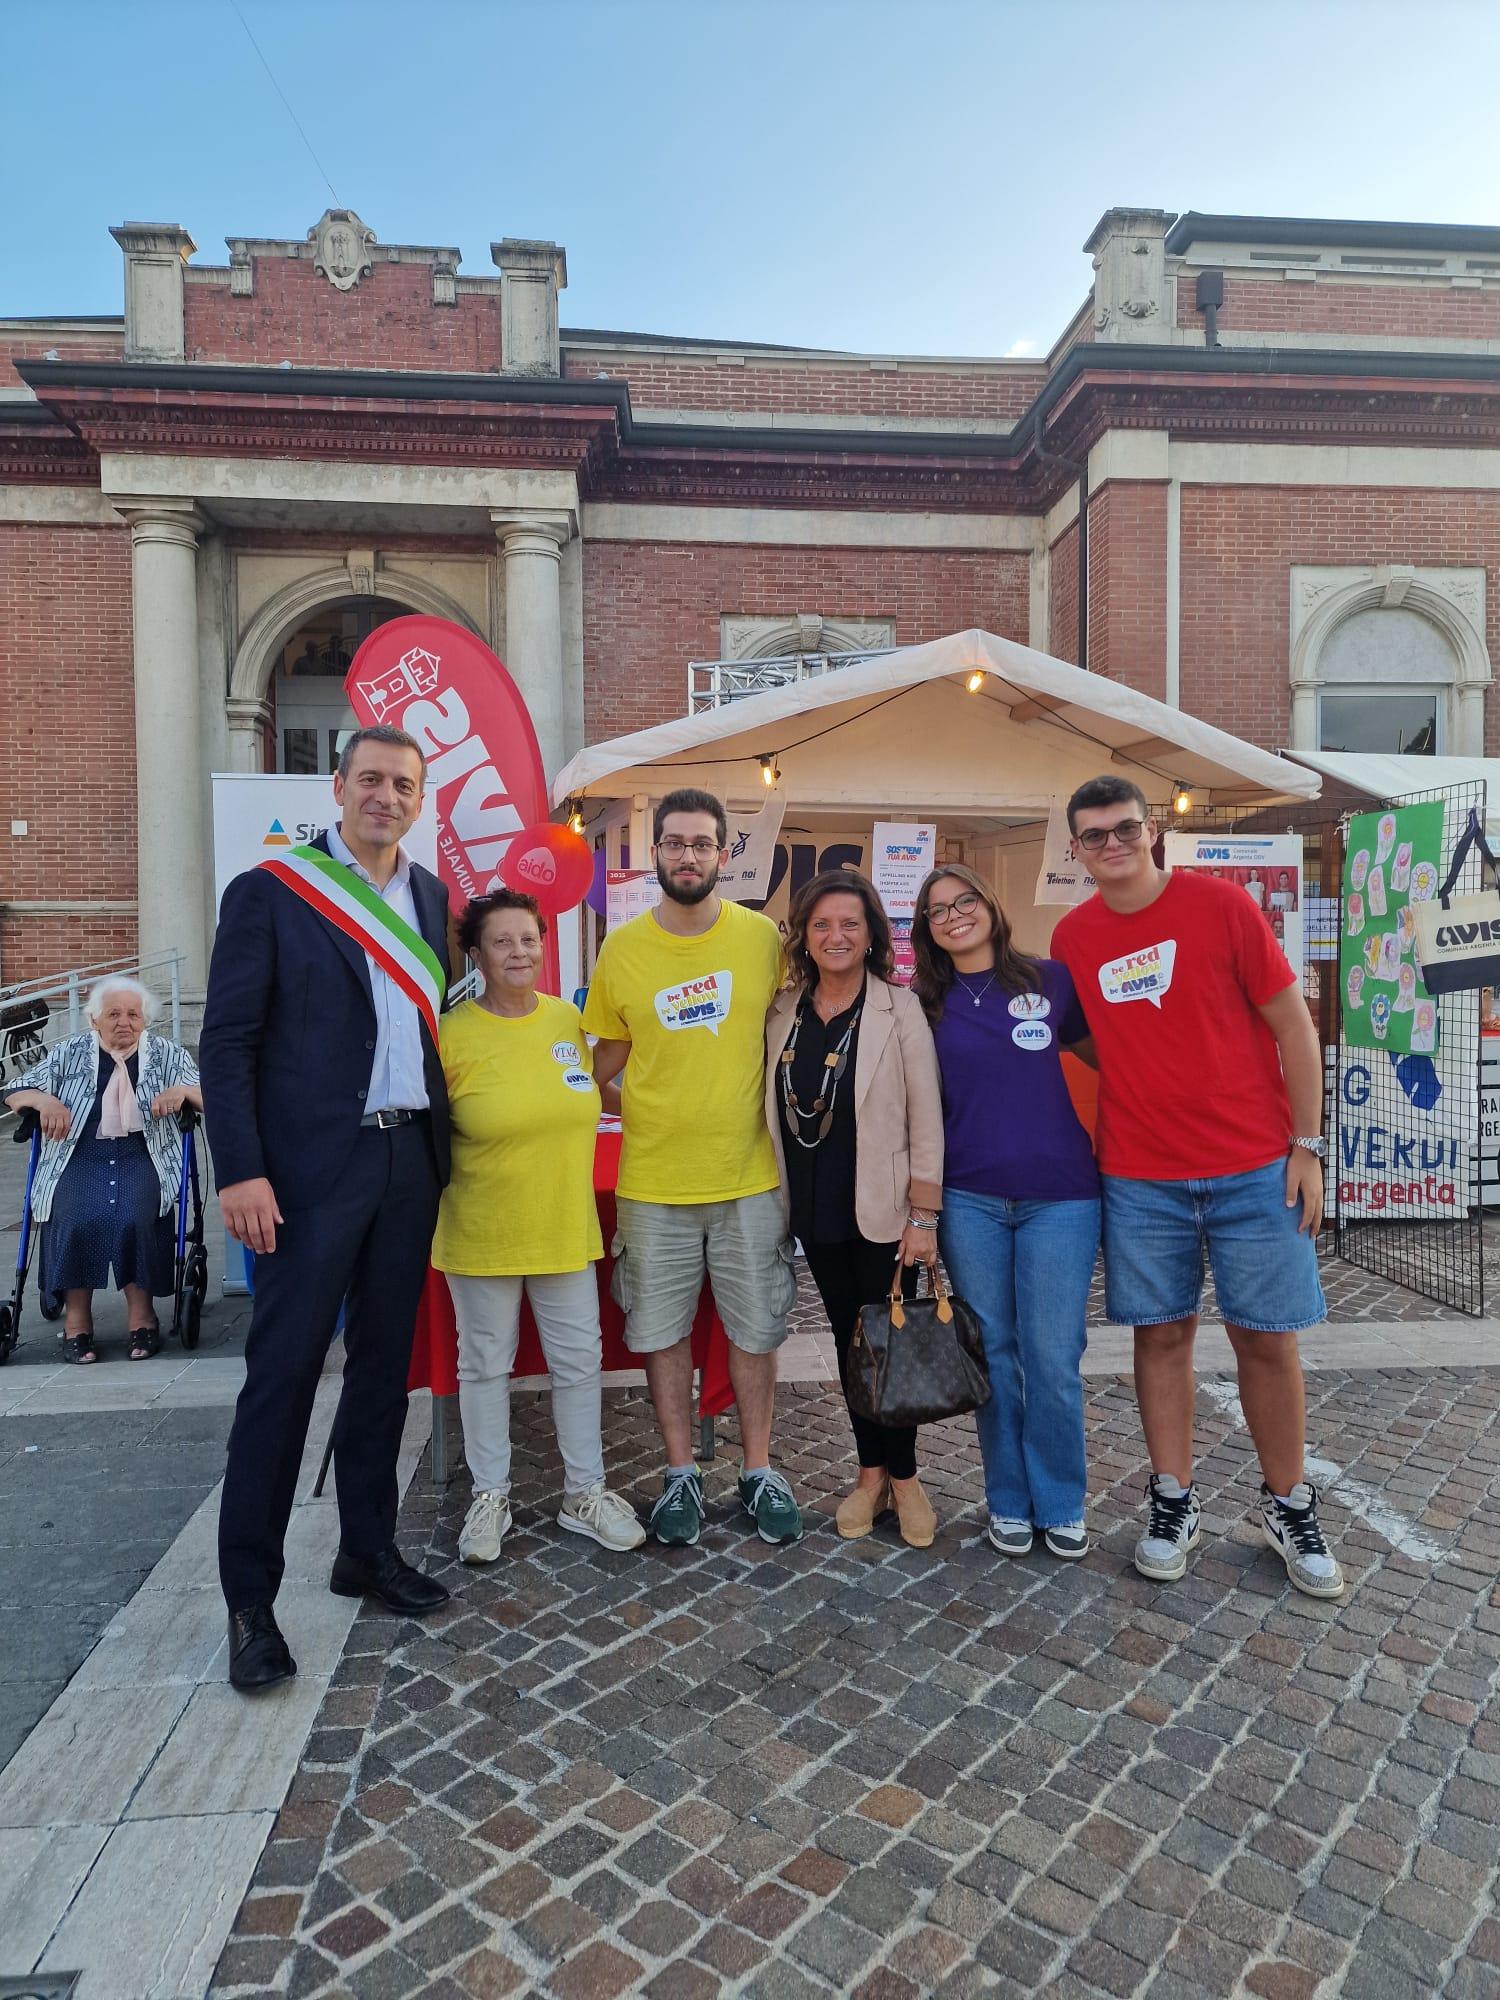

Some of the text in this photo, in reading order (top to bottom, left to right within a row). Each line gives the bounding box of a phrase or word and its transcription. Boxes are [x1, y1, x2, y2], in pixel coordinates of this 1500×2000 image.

[1197, 848, 1230, 860] AVIS
[519, 858, 554, 881] aido
[741, 867, 757, 879] noi
[1046, 872, 1096, 885] Telethon no
[1470, 942, 1496, 950] ARGENTA
[1111, 947, 1160, 975] be red
[667, 975, 718, 1002] be red
[1121, 974, 1158, 993] AVIS
[671, 990, 718, 1013] yellow
[678, 1002, 716, 1021] AVIS
[1016, 1029, 1045, 1038] AVIS
[1338, 1174, 1456, 1210] argenta
